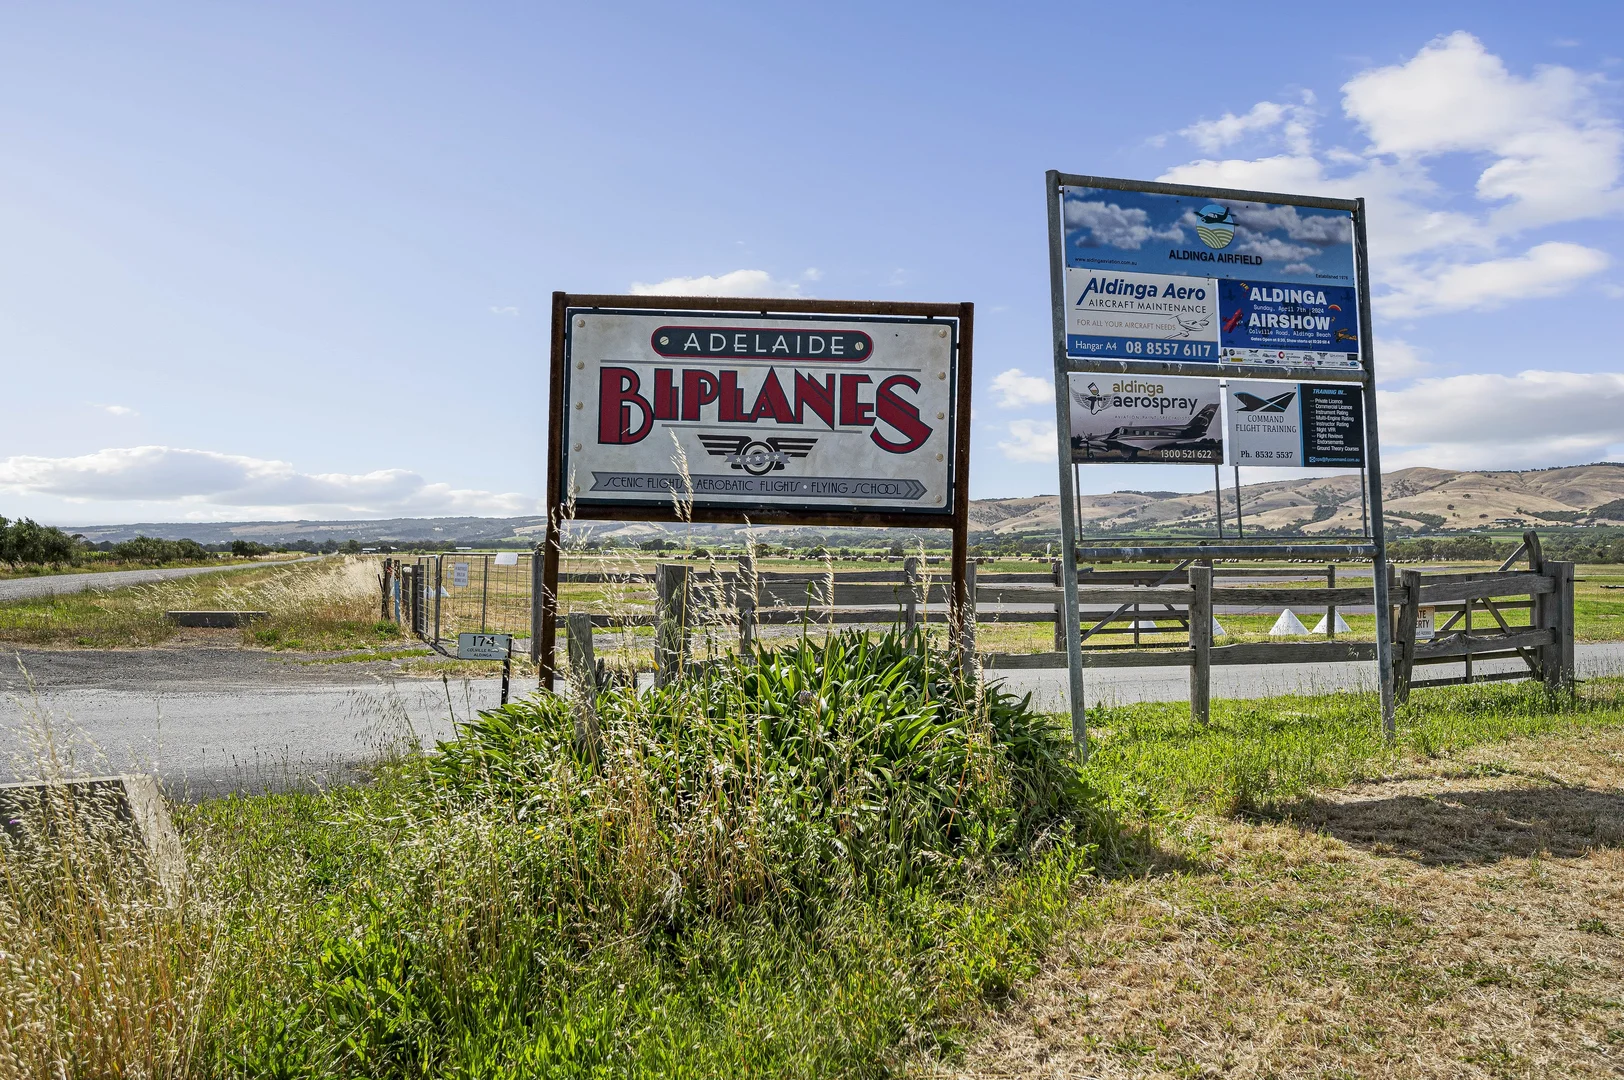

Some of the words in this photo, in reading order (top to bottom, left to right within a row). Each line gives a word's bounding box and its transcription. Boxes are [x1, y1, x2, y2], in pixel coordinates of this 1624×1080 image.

[1169, 250, 1215, 262] ALDINGA
[1217, 253, 1263, 265] AIRFIELD
[1076, 277, 1158, 306] Aldinga
[1162, 283, 1206, 300] Aero
[1249, 287, 1327, 305] ALDINGA
[1088, 299, 1135, 309] AIRCRAFT
[1137, 302, 1207, 314] MAINTENANCE
[1278, 305, 1294, 313] April
[1104, 320, 1123, 328] YOUR
[1123, 322, 1154, 330] AIRCRAFT
[1155, 323, 1176, 331] NEEDS
[1248, 312, 1331, 331] AIRSHOW
[1292, 330, 1315, 338] Aldinga
[683, 332, 844, 355] ADELAIDE
[1075, 340, 1103, 352] Hangar
[1105, 342, 1117, 350] A4
[1125, 341, 1142, 354] 08
[1146, 342, 1179, 355] 8557
[1183, 343, 1211, 357] 6117
[1112, 380, 1164, 397] aldinga
[598, 366, 934, 454] BIPLANES
[1113, 395, 1198, 415] aerospray
[1247, 414, 1285, 423] COMMAND
[1235, 423, 1261, 432] FLIGHT
[1262, 424, 1297, 433] TRAINING
[1160, 449, 1181, 458] 1300
[1182, 450, 1195, 458] 521
[1197, 450, 1212, 459] 622
[1240, 450, 1253, 458] Ph.
[1255, 450, 1273, 459] 8532
[1276, 451, 1294, 459] 5537
[604, 476, 643, 488] SCENIC
[647, 477, 684, 489] FLIGHTS
[696, 479, 754, 491] AEROBATIC
[760, 481, 801, 492] FLIGHTS
[811, 481, 848, 494] FLYING
[852, 482, 902, 495] SCHOOL
[472, 635, 495, 647] 174
